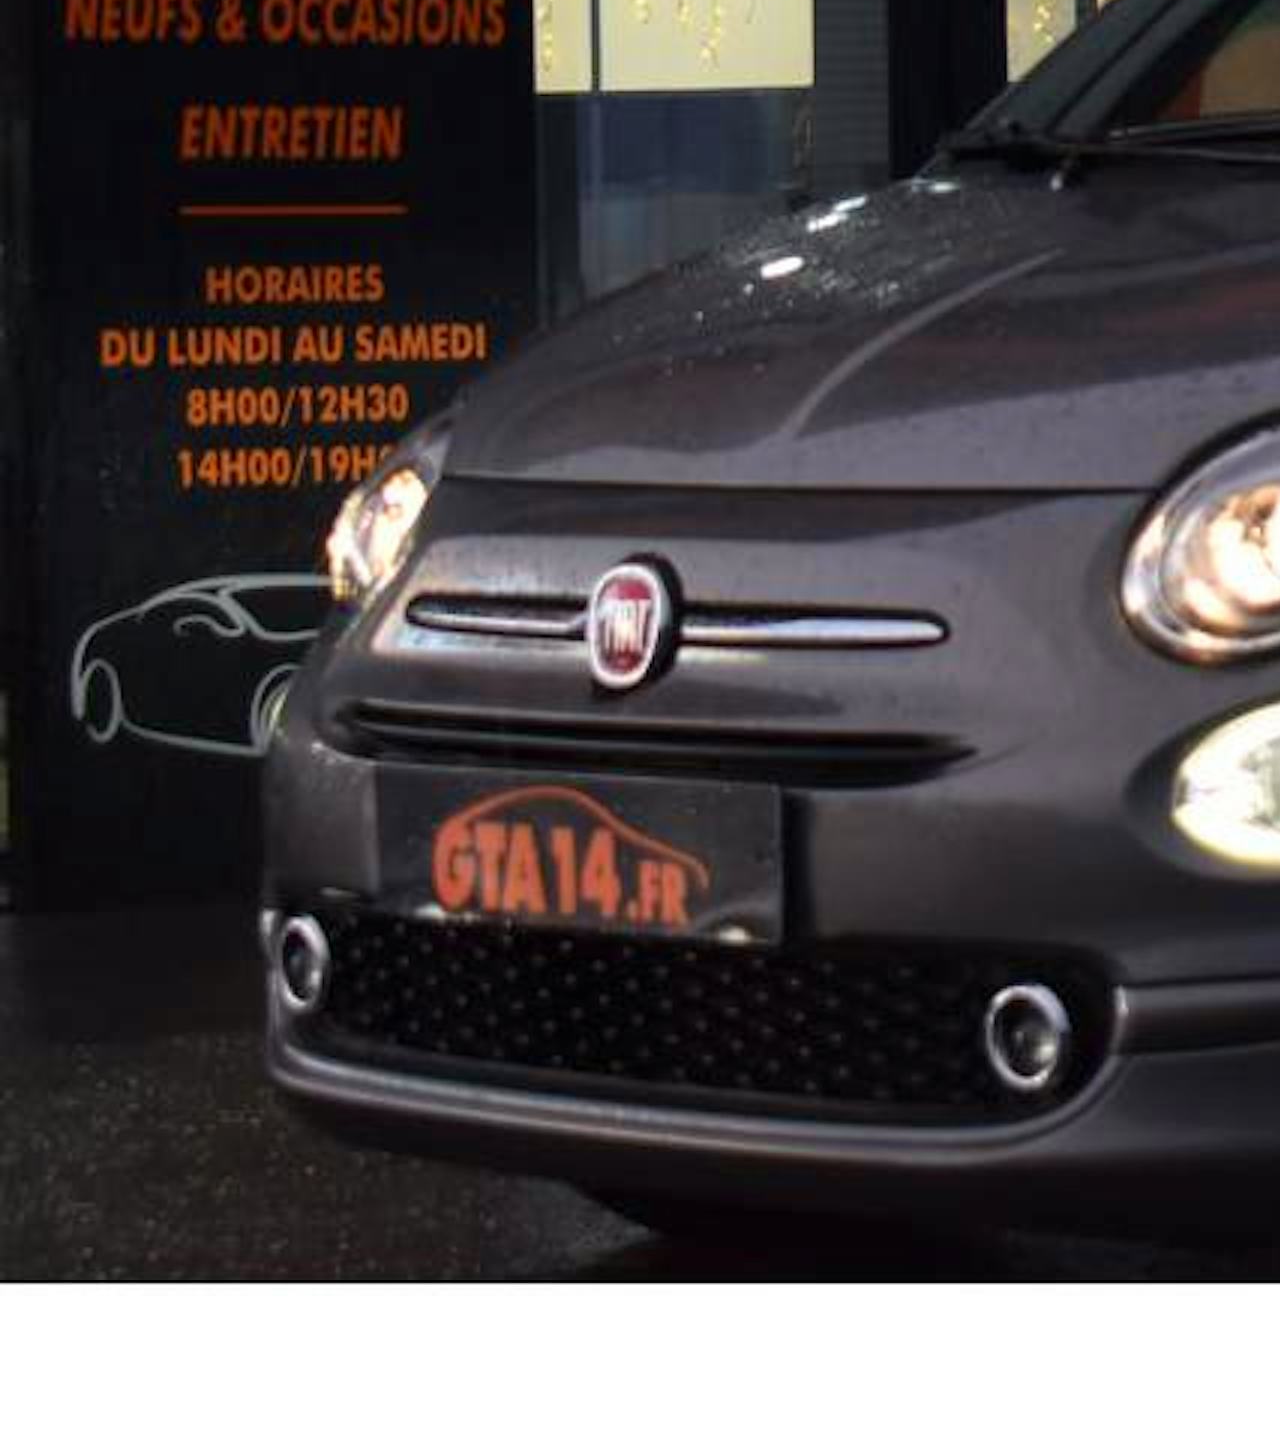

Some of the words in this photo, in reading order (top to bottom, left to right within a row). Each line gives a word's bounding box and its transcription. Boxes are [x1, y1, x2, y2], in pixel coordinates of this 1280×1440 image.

[180, 106, 402, 158] ENTRETIEN
[207, 266, 384, 304] HORAIRES
[102, 327, 155, 366] DU
[169, 328, 280, 364] LUNDI
[294, 326, 344, 362] AU
[356, 324, 486, 360] SAMEDI
[186, 385, 409, 427] 8H00/12H30
[432, 817, 688, 926] GTA14.FR
